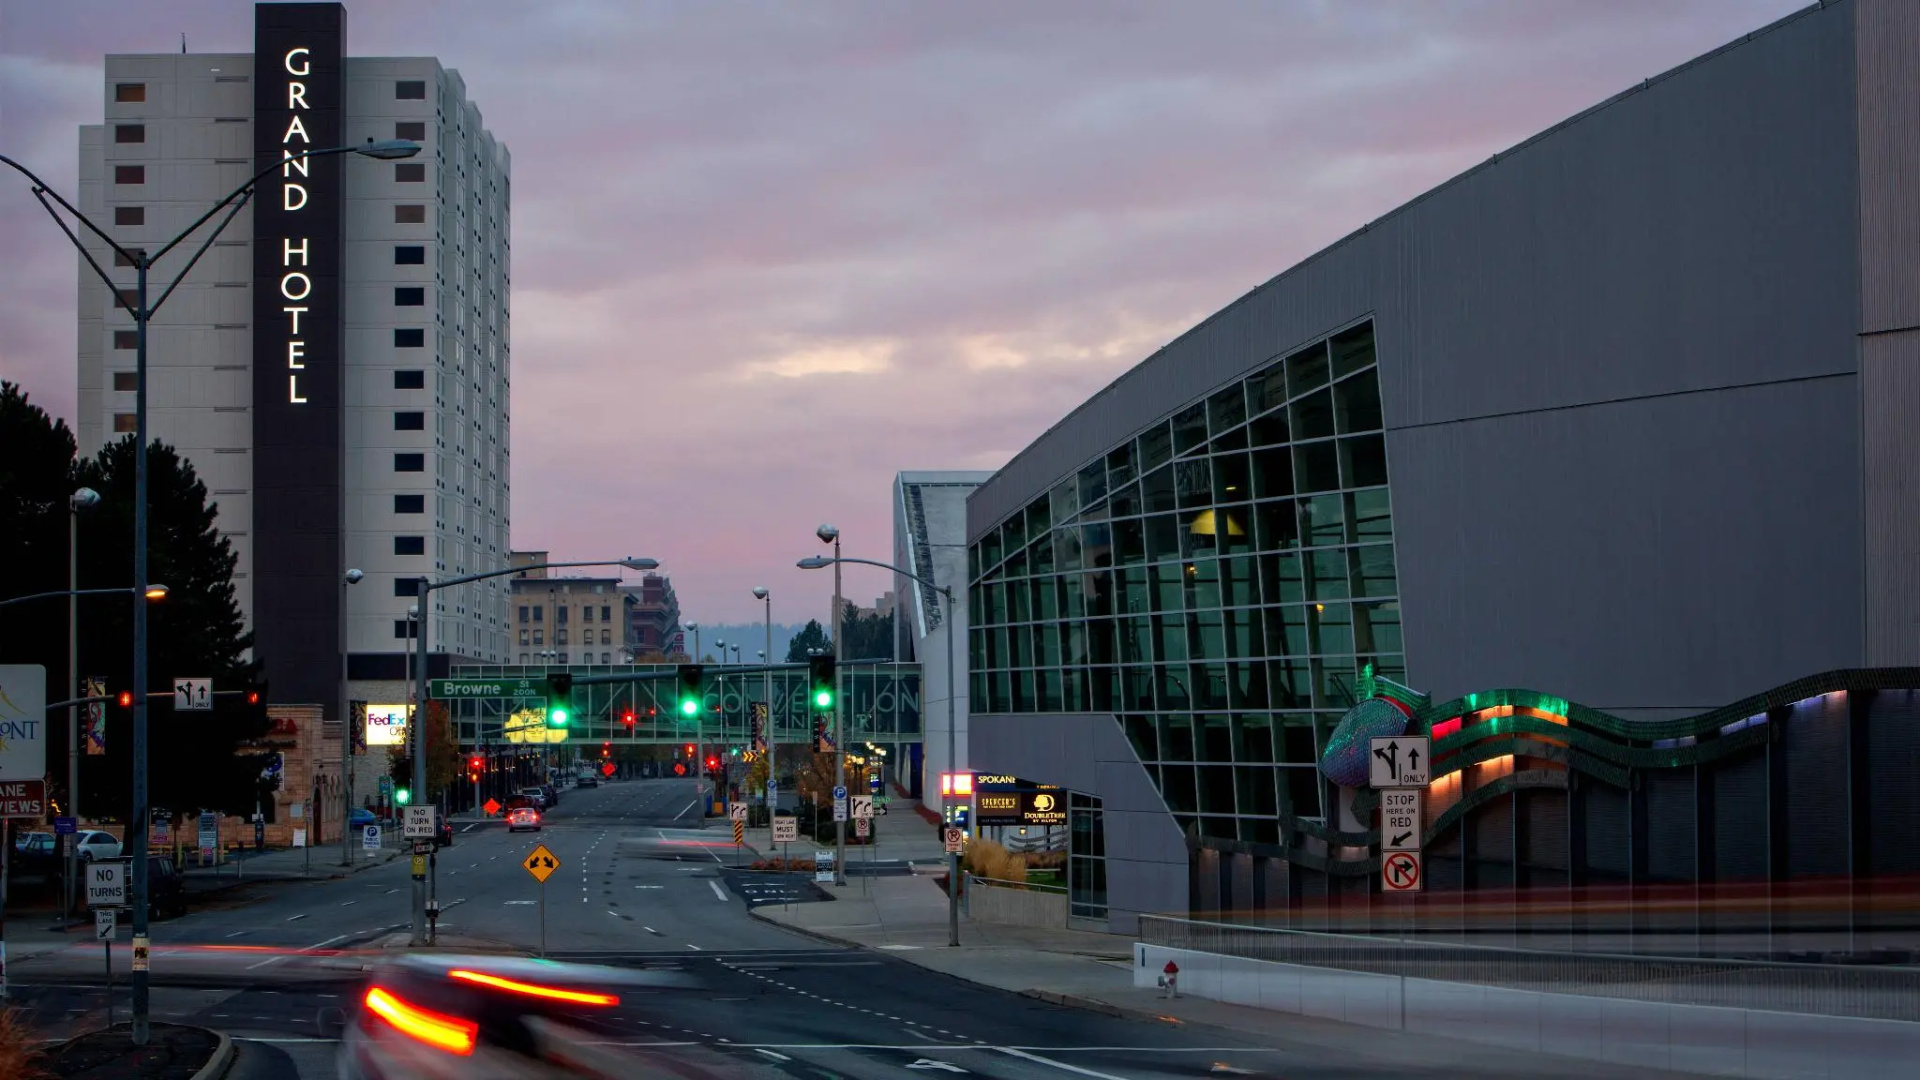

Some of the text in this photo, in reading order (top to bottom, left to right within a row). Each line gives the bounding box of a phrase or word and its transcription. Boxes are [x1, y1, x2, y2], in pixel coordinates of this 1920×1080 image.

[281, 48, 311, 403] GRAND HOTEL
[444, 682, 501, 695] Browne
[520, 680, 530, 688] St
[368, 713, 405, 726] FedEx
[1404, 775, 1426, 783] ONLY
[1387, 796, 1415, 805] STOP
[1390, 817, 1412, 827] RED
[96, 869, 114, 882] NO
[89, 887, 122, 897] TURNS
